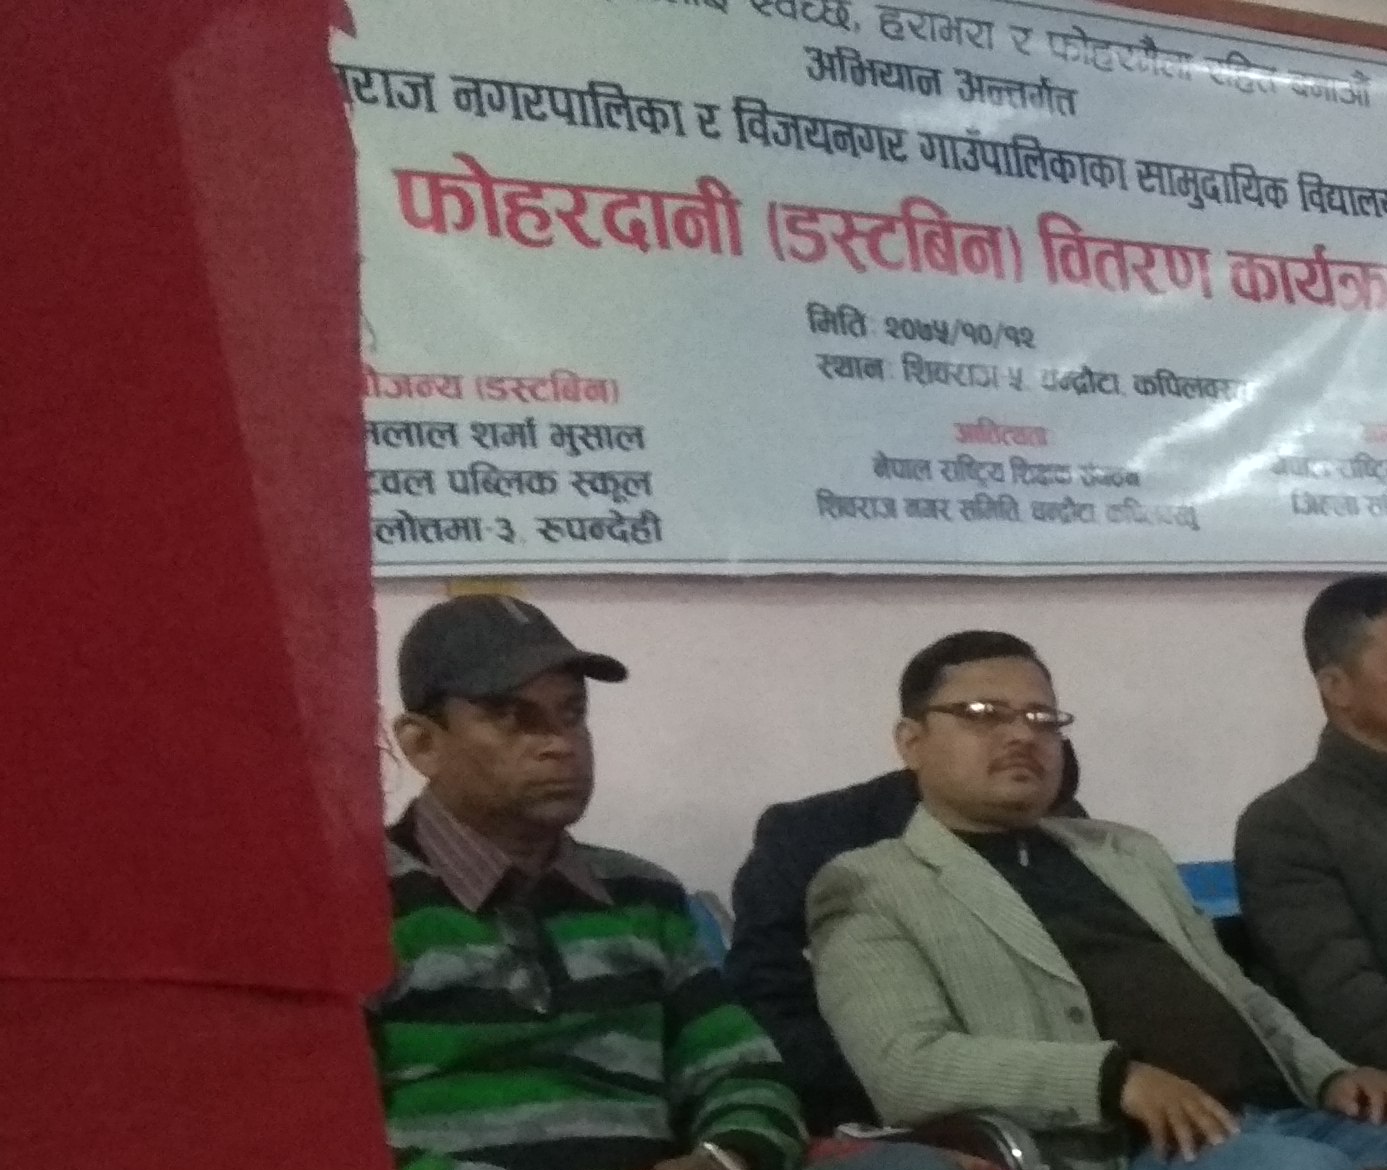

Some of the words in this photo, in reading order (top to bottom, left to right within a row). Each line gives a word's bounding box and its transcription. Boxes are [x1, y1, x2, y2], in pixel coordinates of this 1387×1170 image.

[875, 4, 994, 50] हराभरा
[1008, 24, 1033, 57] र
[804, 45, 944, 97] अभियान
[450, 79, 687, 137] नगरपालिका
[694, 102, 721, 140] र
[732, 95, 908, 162] विजयनगर
[917, 125, 1128, 191] गाउँपालिकाका
[1135, 161, 1290, 211] सामुदायिक
[392, 152, 743, 257] फोहरदानी
[766, 196, 1023, 283] (डस्टबिन)
[1037, 210, 1213, 299] वितरण
[885, 315, 1037, 350] २०७५/१०/१२
[470, 416, 537, 450] शर्मा
[550, 421, 646, 457] भुसाल
[447, 460, 557, 498] पब्लिक
[569, 469, 652, 503] स्कूल
